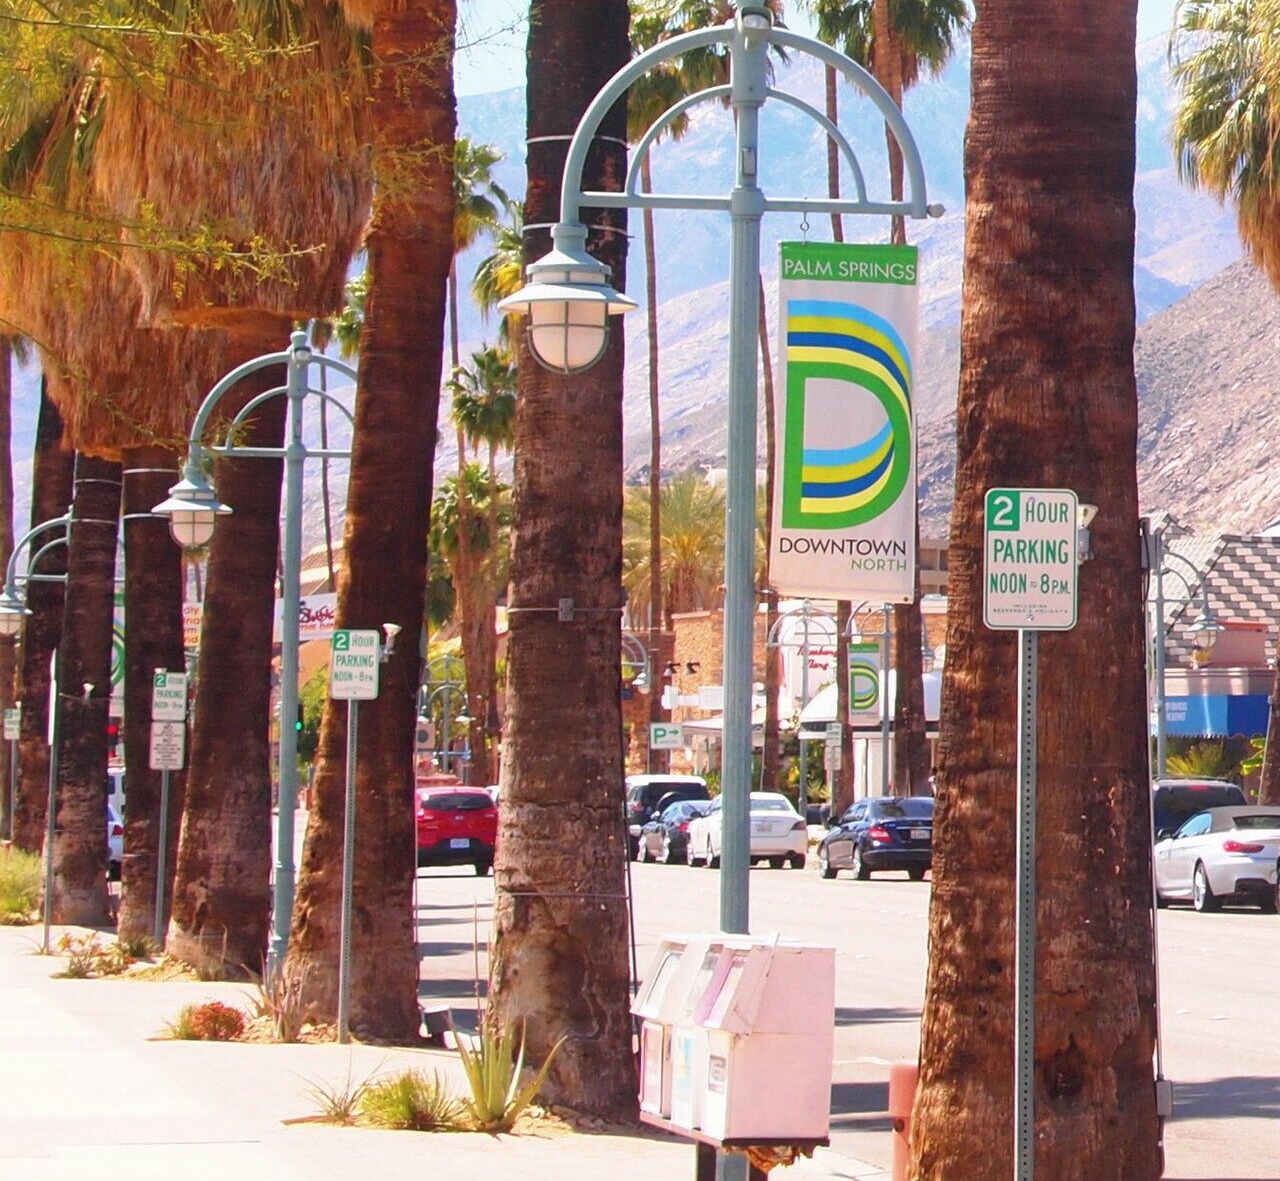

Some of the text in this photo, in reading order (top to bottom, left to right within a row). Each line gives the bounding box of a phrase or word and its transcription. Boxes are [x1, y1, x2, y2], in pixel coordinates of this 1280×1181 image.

[783, 259, 916, 280] PALM SPRINGS
[992, 495, 1069, 527] 2 HOUR
[780, 537, 906, 557] DOWNTOWN
[993, 539, 1069, 565] PARKING
[851, 558, 907, 571] NORTH
[990, 573, 1027, 594] NOON
[335, 633, 347, 649] 2
[336, 654, 374, 668] PARKING
[156, 674, 166, 687] 2
[653, 728, 667, 745] P
